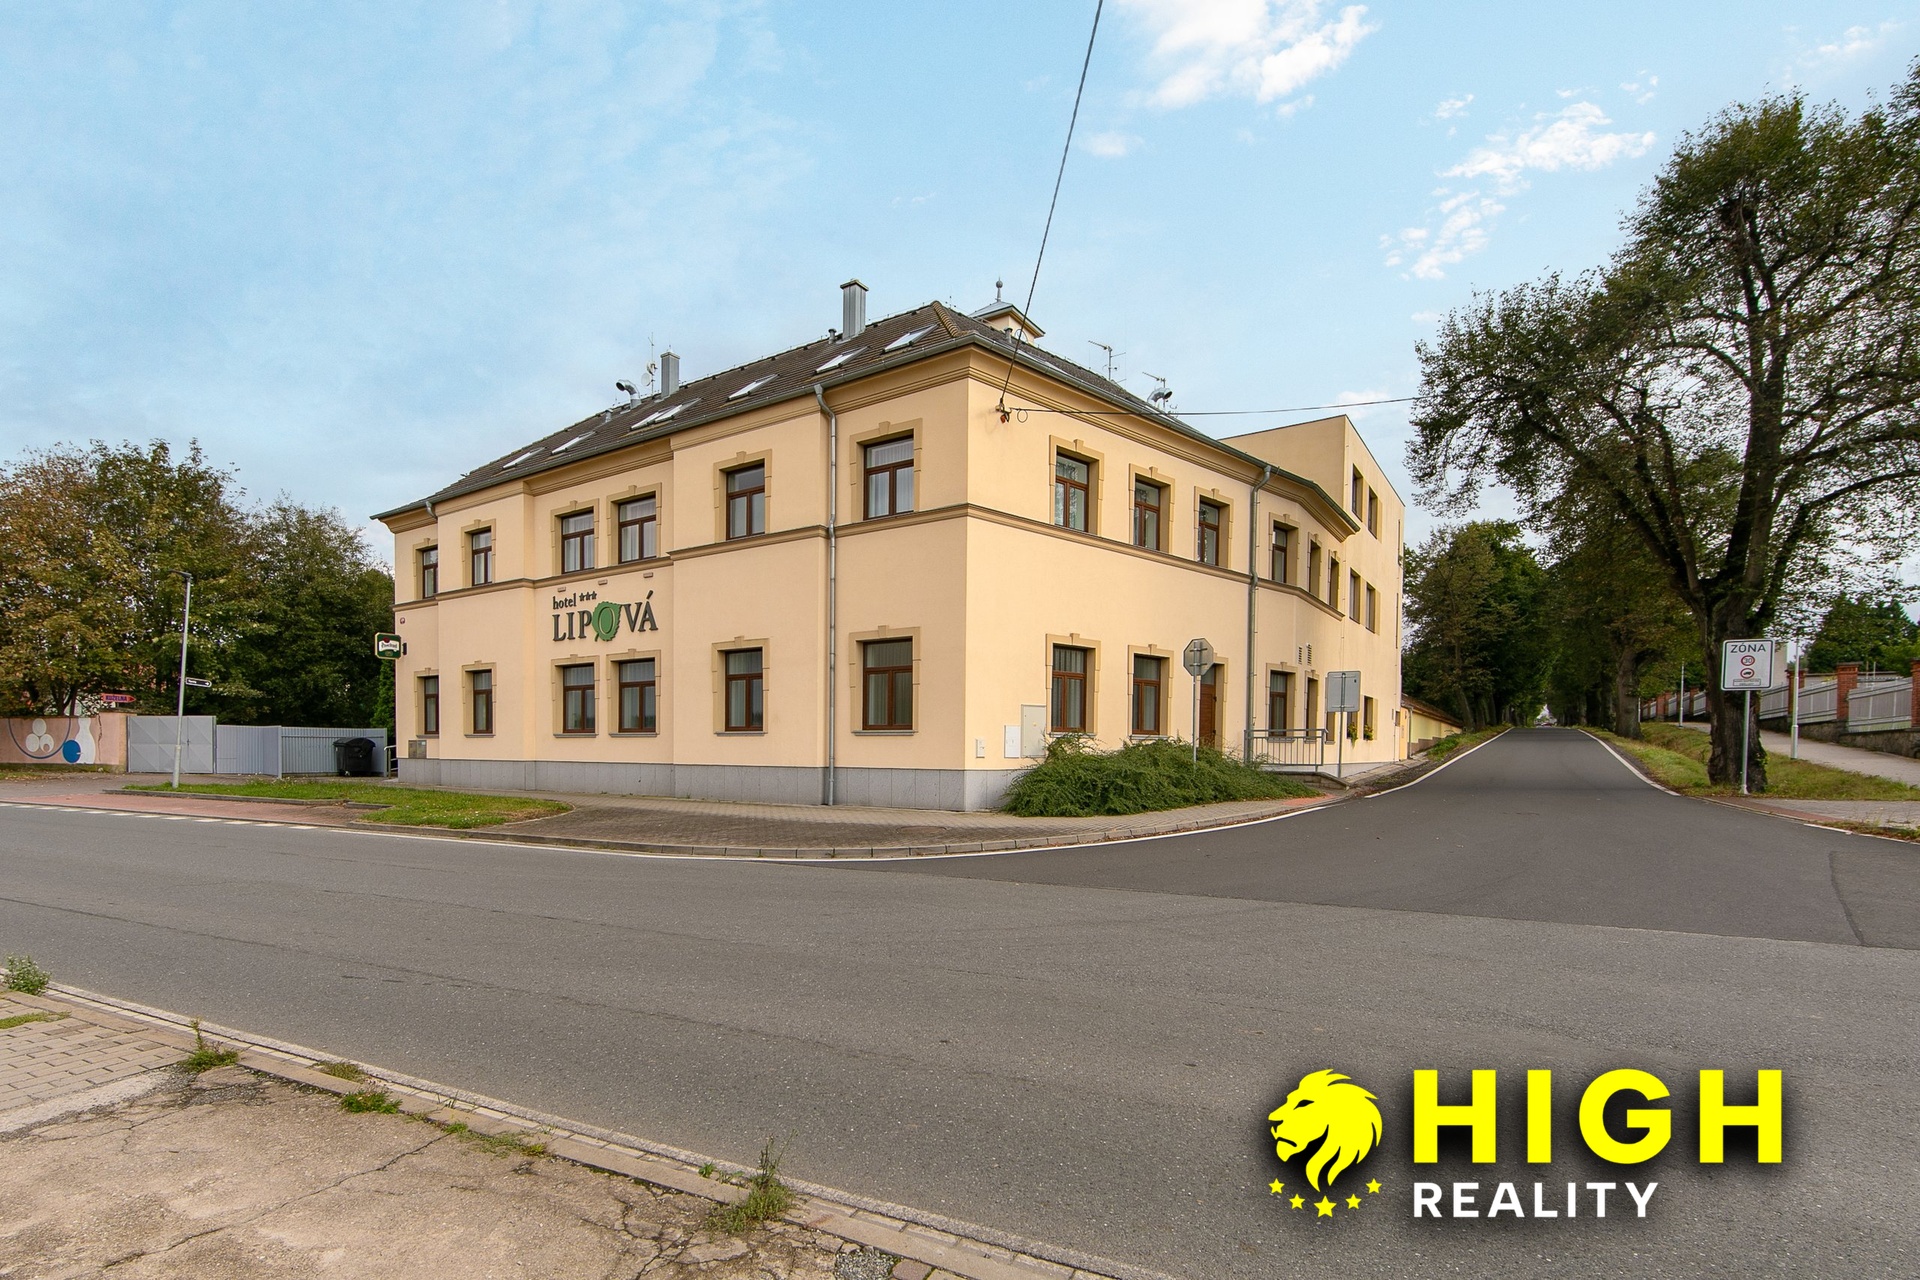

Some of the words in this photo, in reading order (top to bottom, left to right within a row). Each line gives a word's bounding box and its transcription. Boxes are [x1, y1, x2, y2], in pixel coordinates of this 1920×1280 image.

[552, 592, 577, 610] hotel
[552, 590, 659, 642] LIPOVÁ
[1730, 643, 1766, 653] ZÓNA
